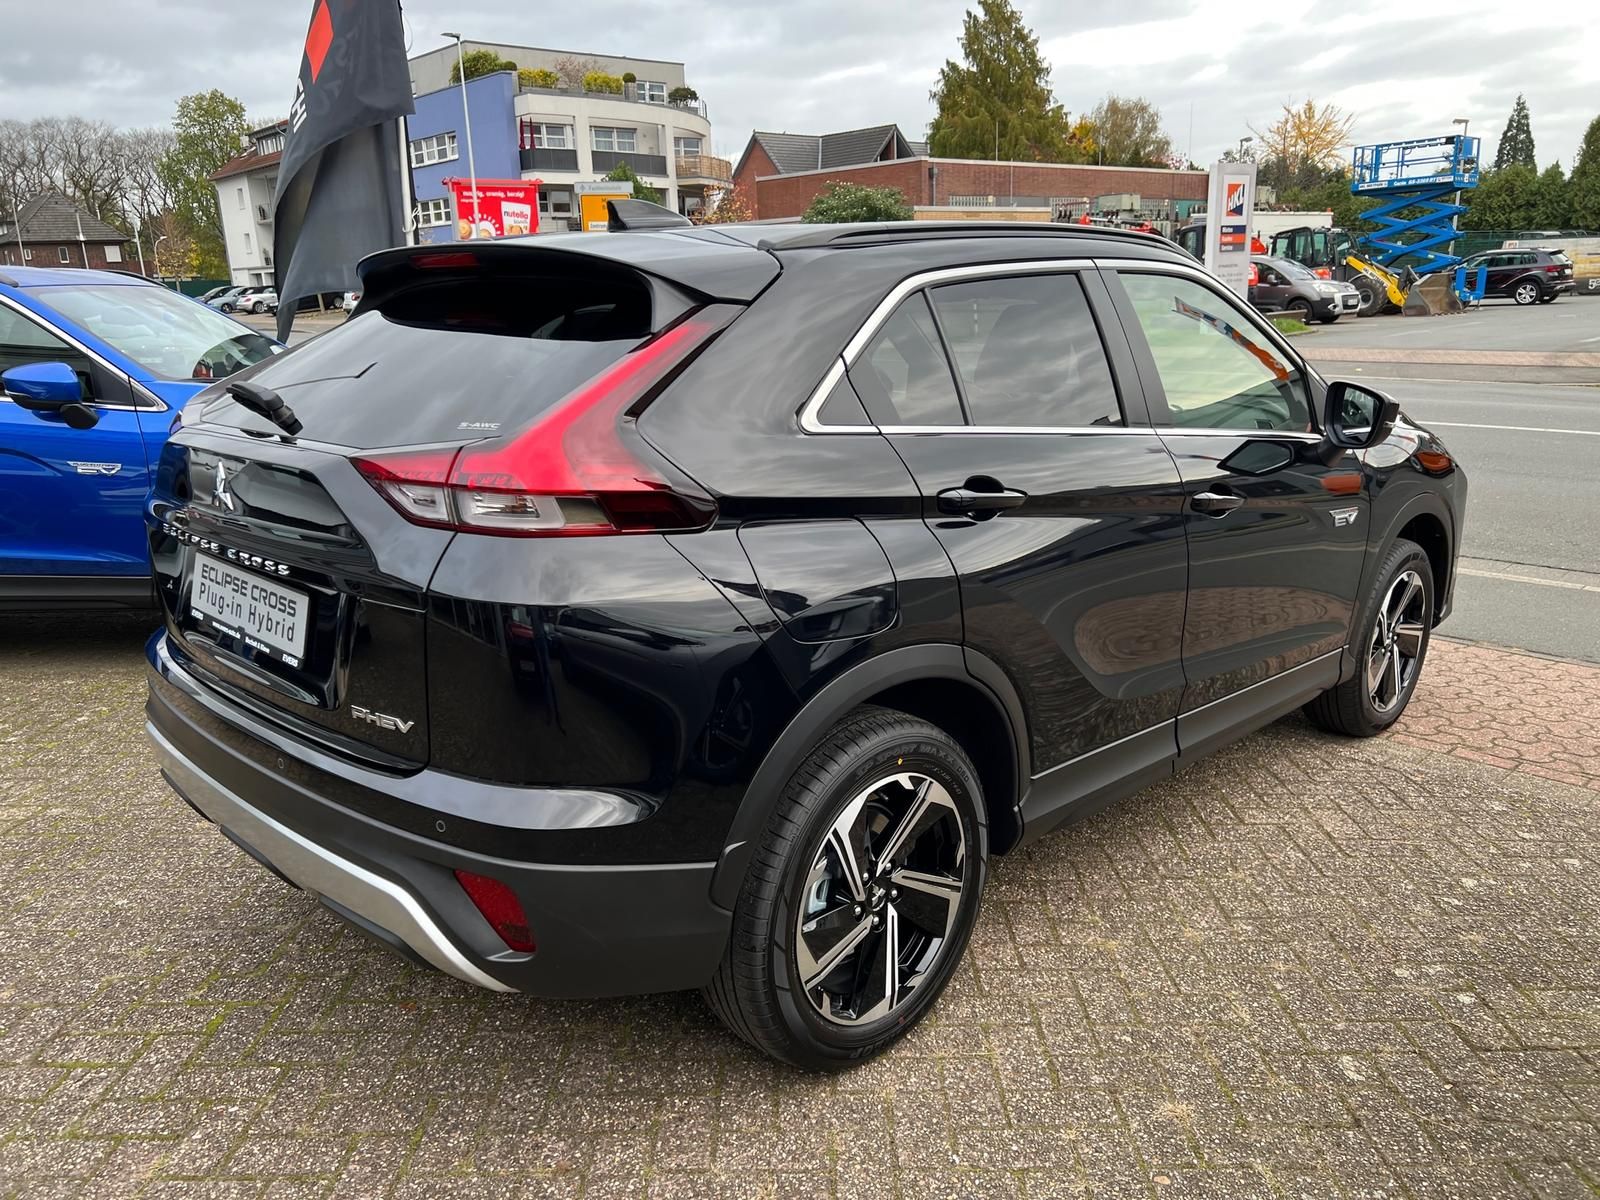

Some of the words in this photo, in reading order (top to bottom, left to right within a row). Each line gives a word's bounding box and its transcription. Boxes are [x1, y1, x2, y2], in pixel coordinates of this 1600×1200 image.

[1228, 184, 1244, 212] HKL
[503, 210, 528, 219] nutella
[459, 422, 504, 430] S-AWC
[162, 522, 220, 555] ECLIPSE
[227, 548, 291, 576] CROSS
[201, 563, 248, 595] ECLIPSE
[250, 586, 297, 618] CROSS
[198, 582, 242, 619] Plug-in
[248, 601, 296, 644] Hybrid
[350, 704, 415, 734] PHEV
[918, 743, 955, 764] MAXX
